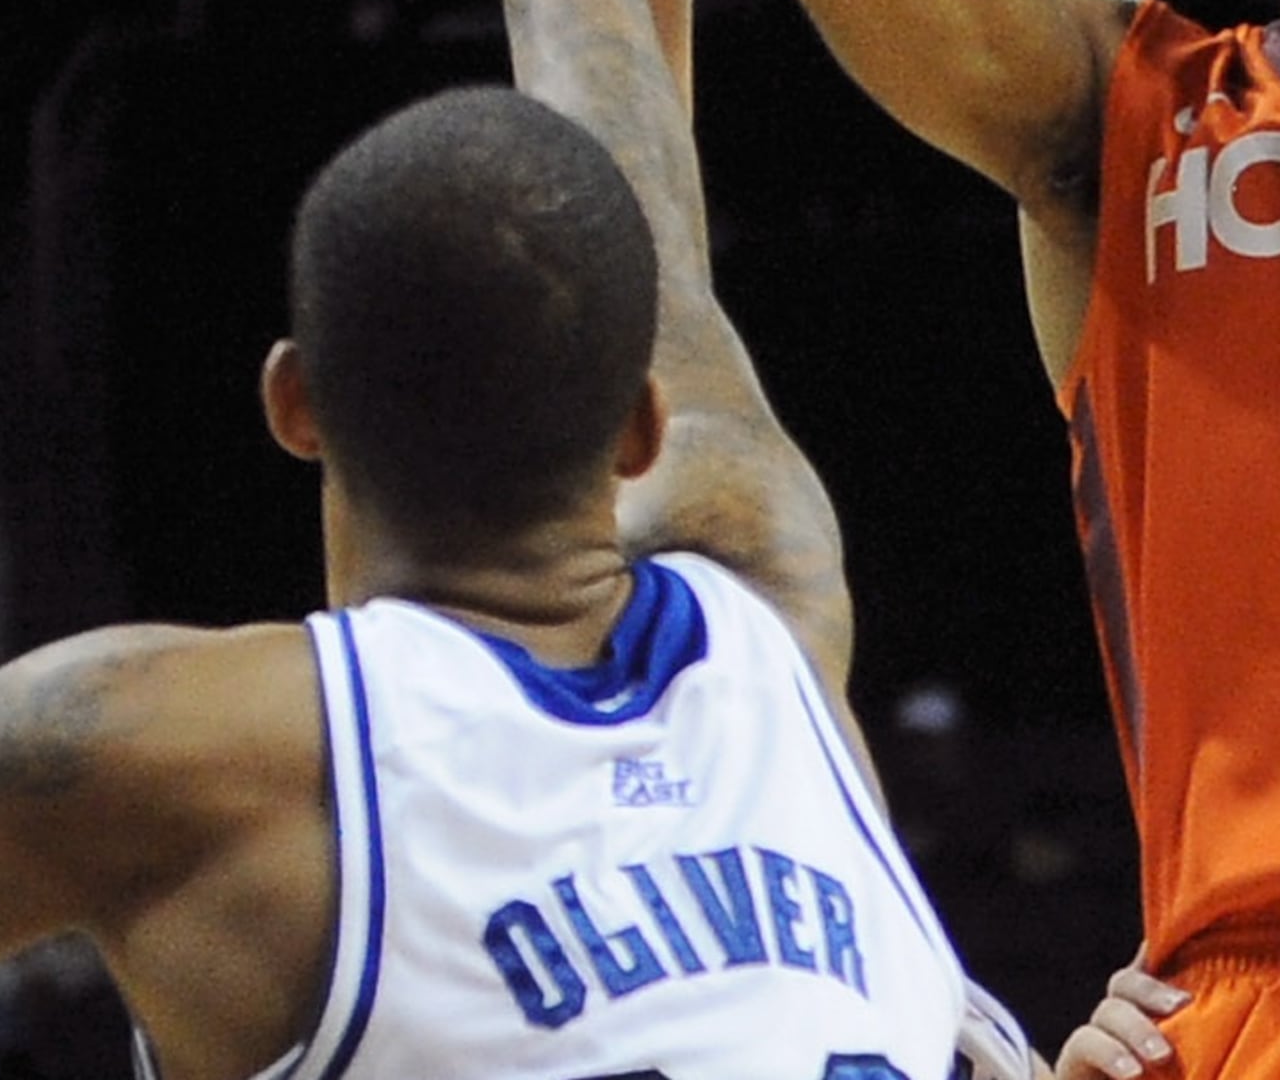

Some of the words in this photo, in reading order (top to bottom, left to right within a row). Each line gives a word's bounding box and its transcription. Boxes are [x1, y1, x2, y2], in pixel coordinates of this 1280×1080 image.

[613, 757, 666, 782] BIG
[612, 778, 698, 808] EAST
[482, 844, 870, 1031] OLIVER
